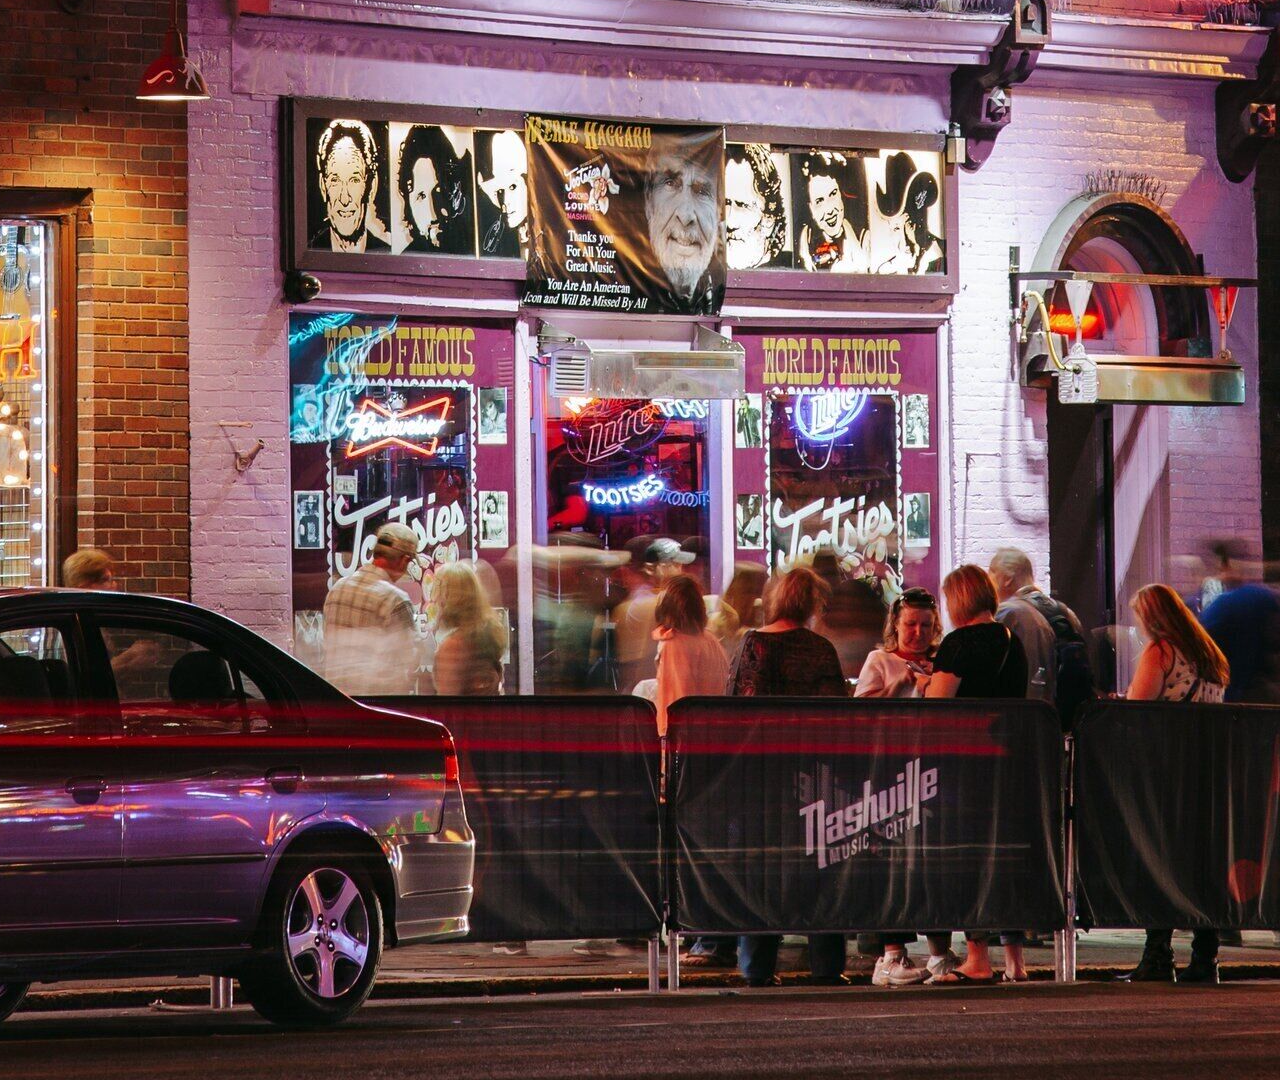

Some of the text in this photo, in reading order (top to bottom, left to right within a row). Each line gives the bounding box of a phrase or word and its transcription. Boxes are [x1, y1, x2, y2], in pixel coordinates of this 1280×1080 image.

[525, 116, 652, 150] MERLE HAGGARD
[564, 165, 601, 192] Tootsies
[566, 245, 616, 259] For All Your
[567, 230, 615, 246] Thanks you
[566, 260, 616, 274] Great Music.
[524, 292, 648, 311] Icon and Will Be Missed By All
[547, 278, 630, 294] You Are An American
[324, 326, 476, 377] WORLD FAMOUS
[762, 337, 902, 386] WORLD FAMOUS
[345, 411, 447, 443] Budweiser
[582, 474, 664, 506] TOOTSIES
[799, 757, 938, 869] Nashville
[829, 813, 912, 865] MUSIC CITY
